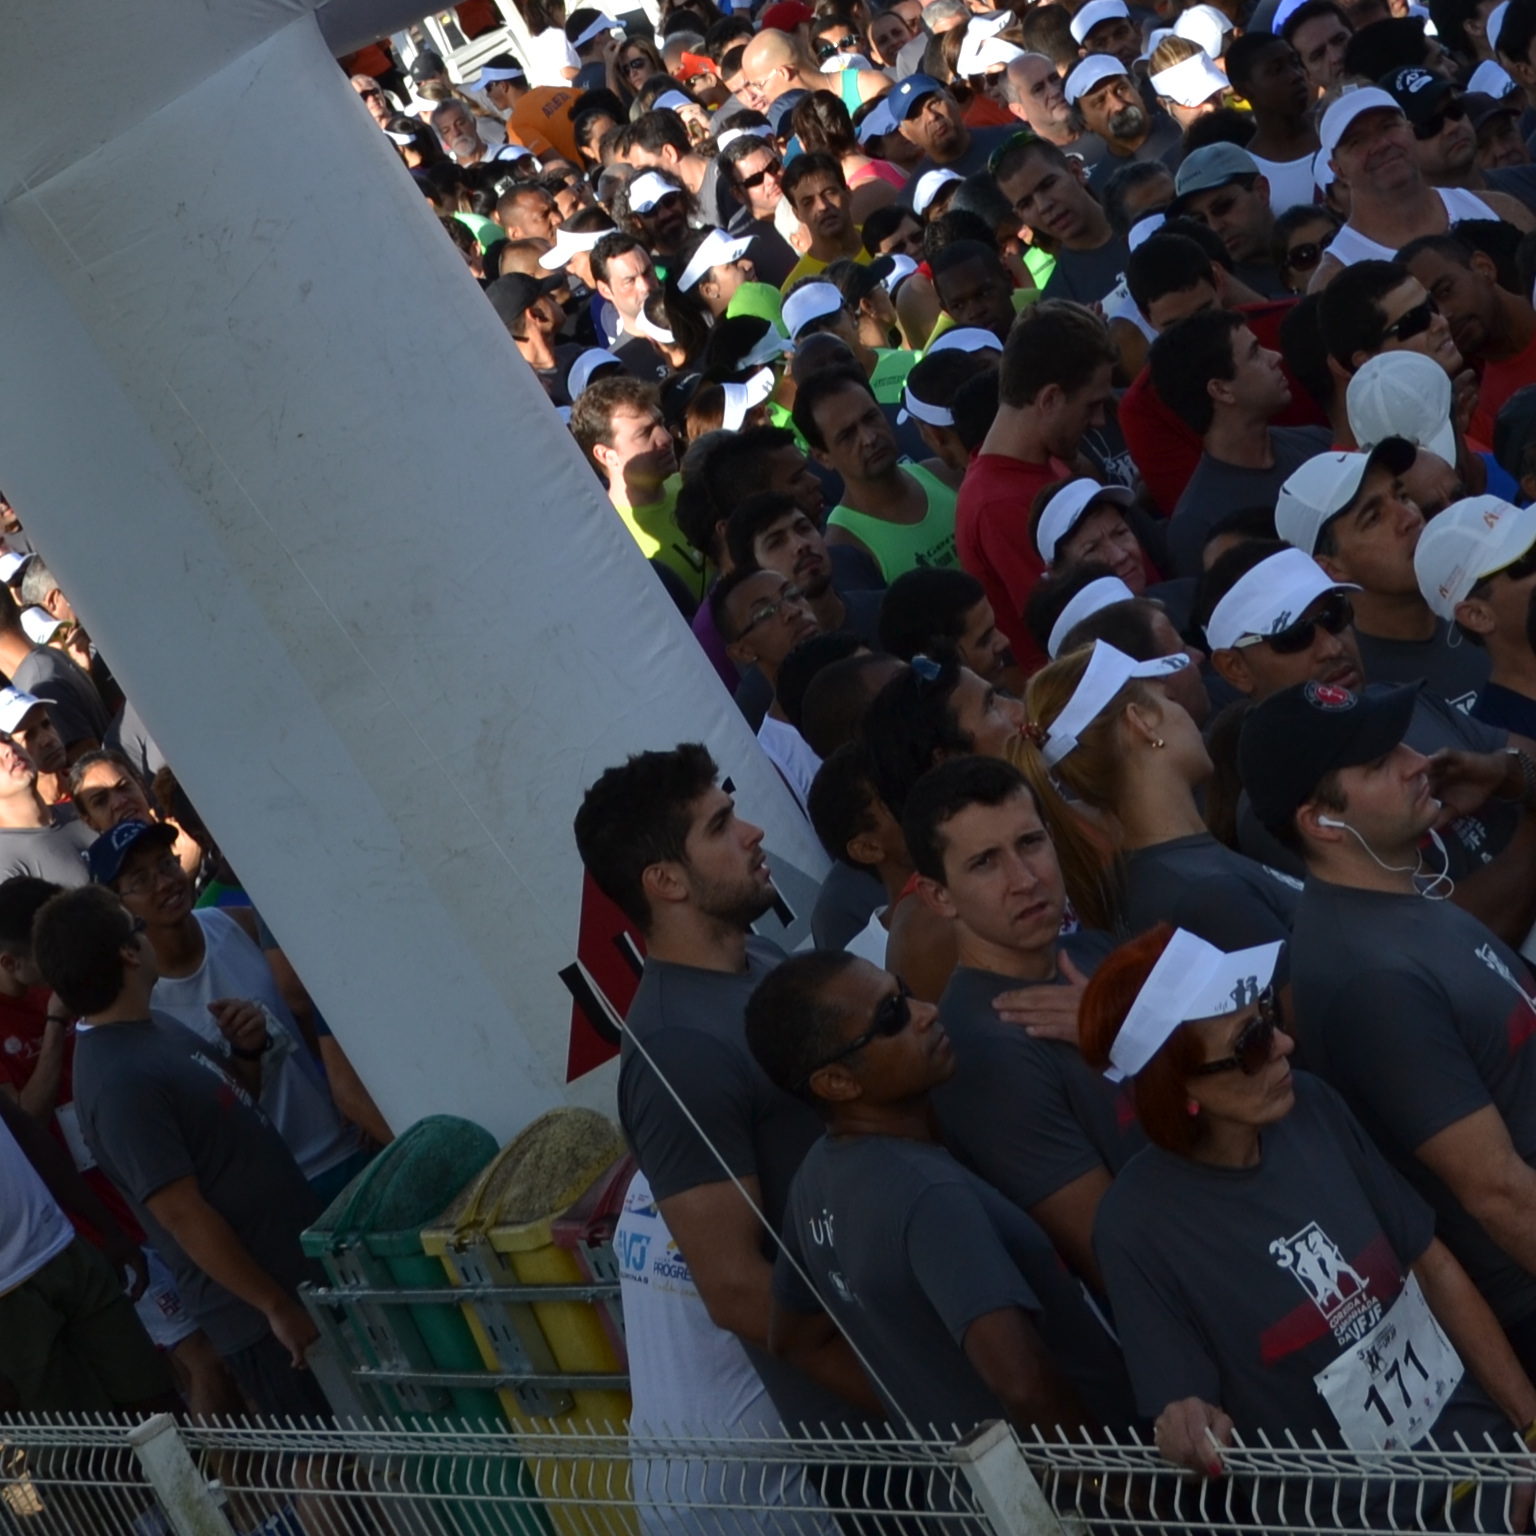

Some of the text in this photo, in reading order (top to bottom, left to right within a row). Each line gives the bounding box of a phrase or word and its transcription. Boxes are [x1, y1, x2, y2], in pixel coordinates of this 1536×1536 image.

[652, 1261, 695, 1283] PROGRE
[1329, 1296, 1362, 1329] CORRIDA
[1333, 1295, 1380, 1337] CAMINHADA
[1338, 1332, 1353, 1348] DA
[1347, 1304, 1383, 1342] UFJF
[1364, 1340, 1430, 1427] 171
